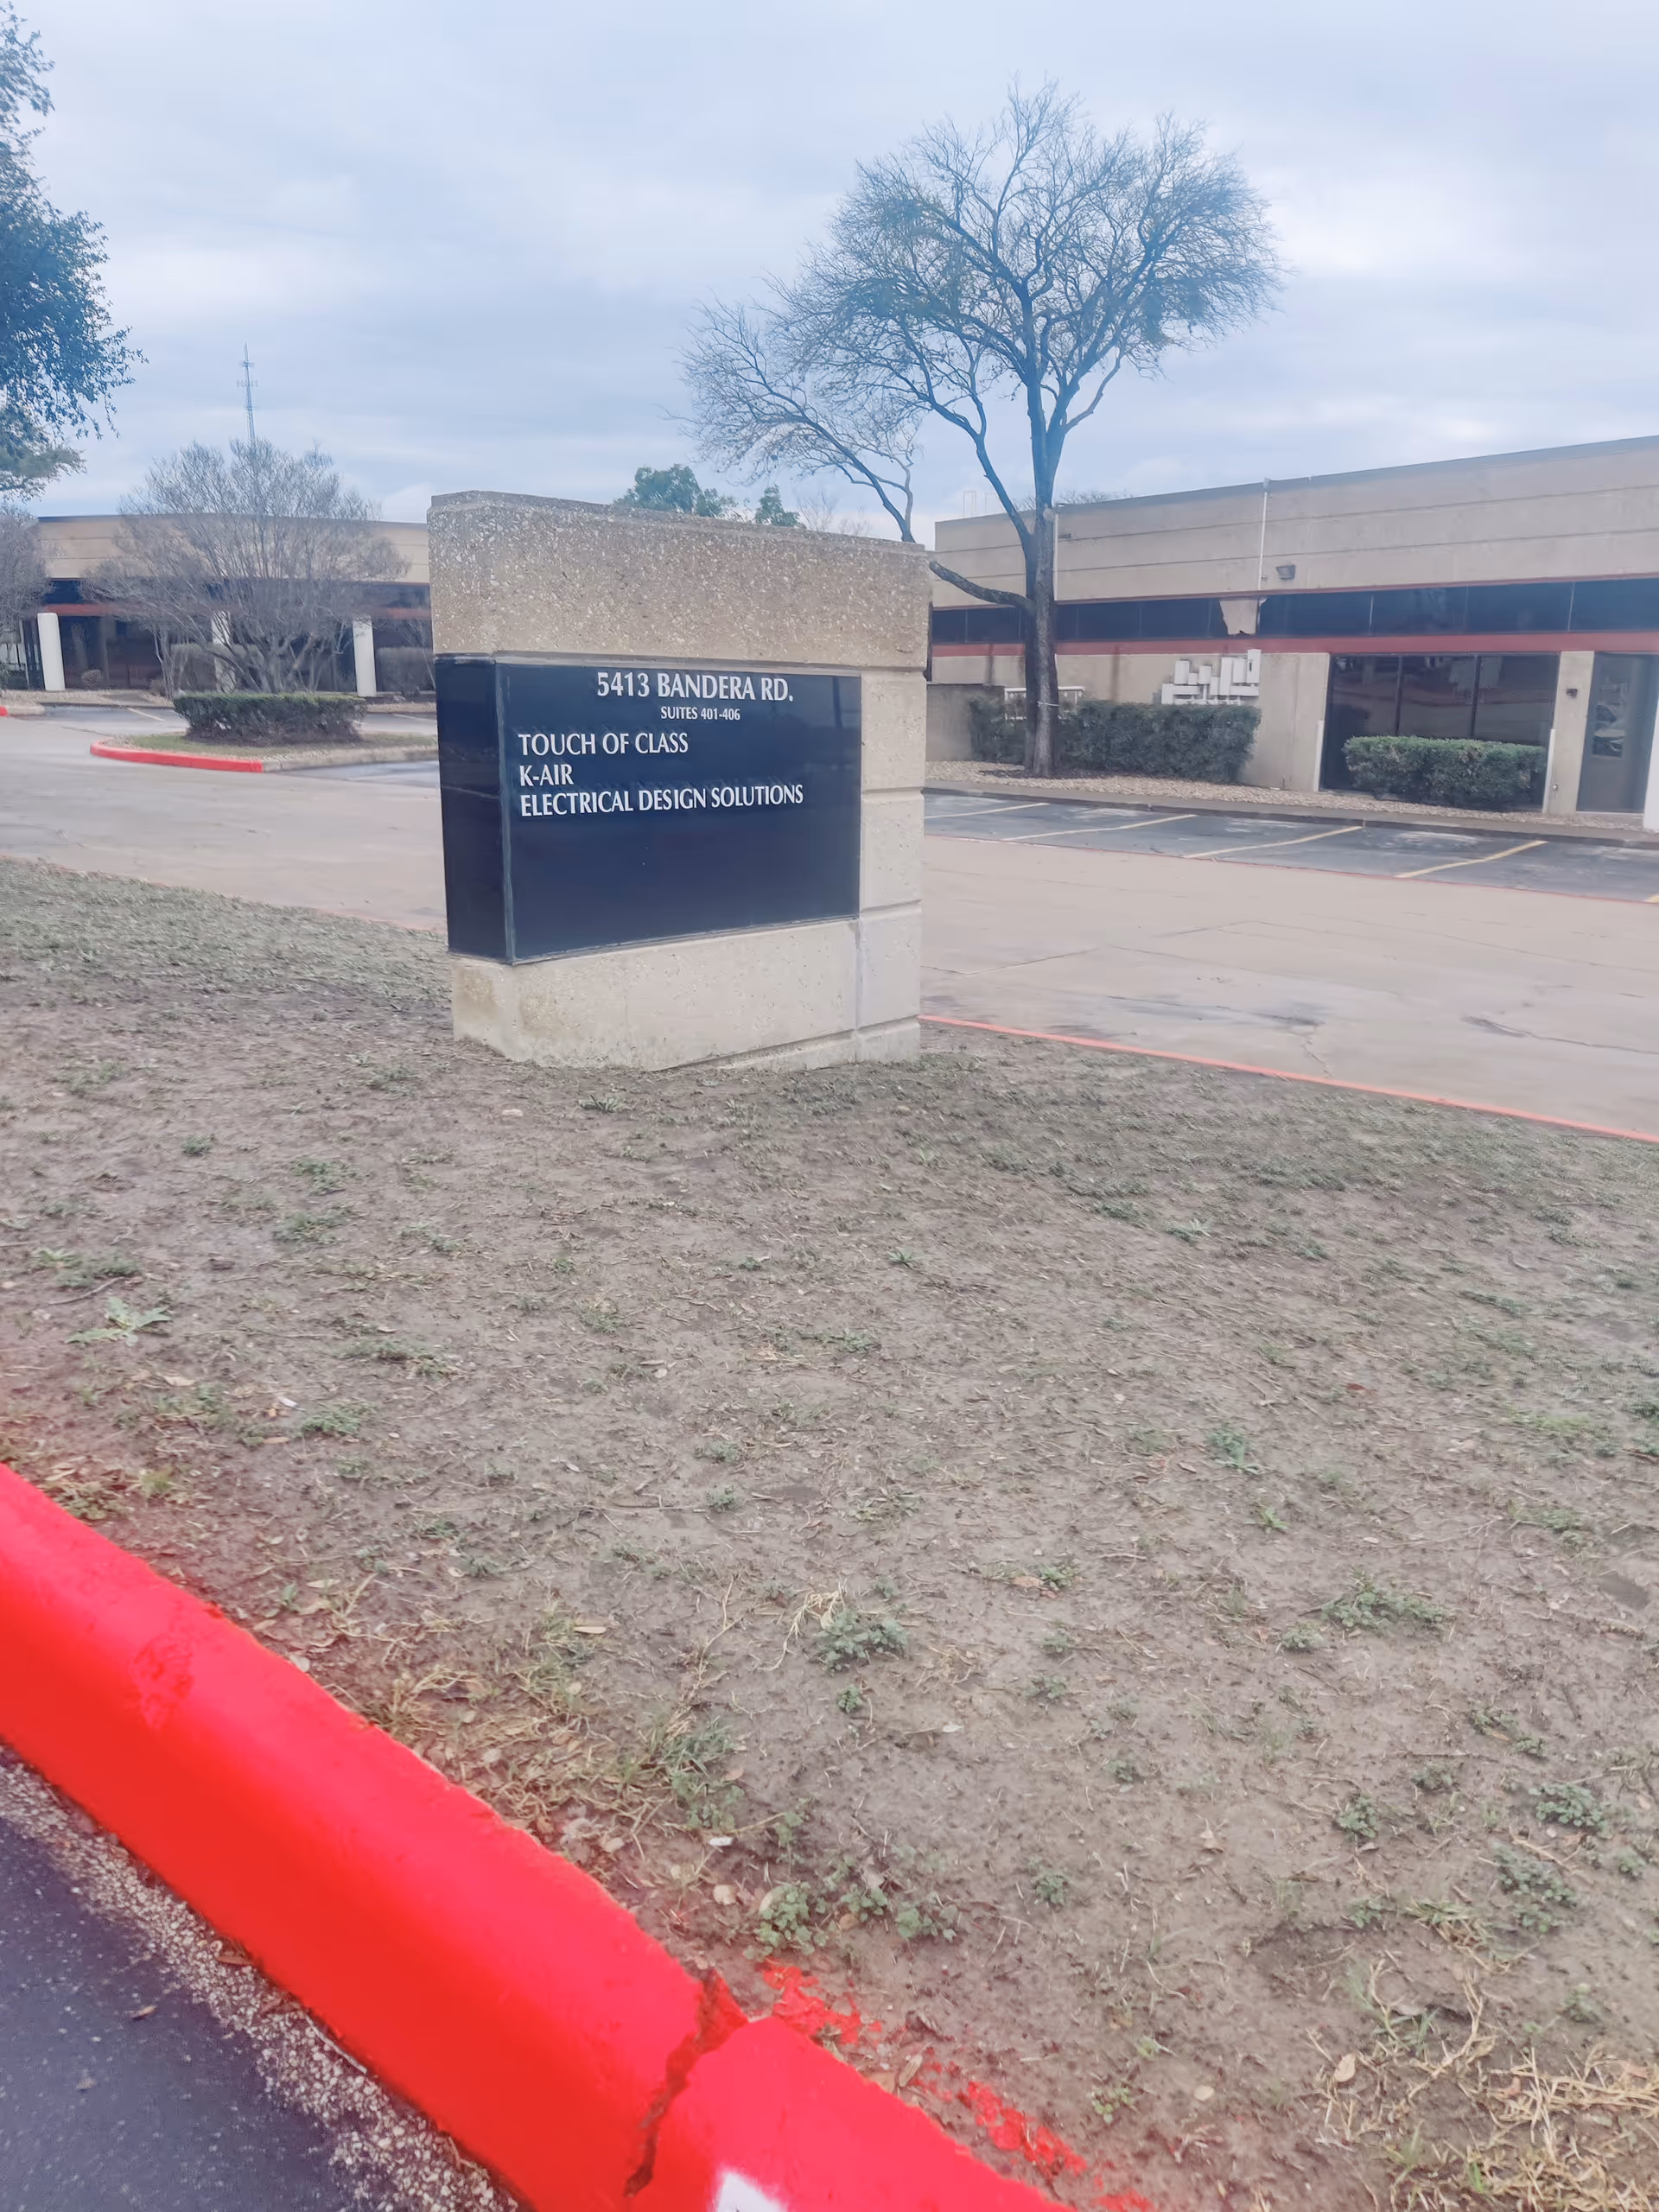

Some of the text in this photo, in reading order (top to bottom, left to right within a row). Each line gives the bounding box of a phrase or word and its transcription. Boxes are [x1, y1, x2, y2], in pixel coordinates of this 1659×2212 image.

[597, 672, 793, 701] 5413 BANDERA RD.
[660, 706, 741, 721] SUITES 401-406
[518, 733, 689, 756] TOUCH OF CLASS
[519, 764, 574, 786] K-AIR
[520, 785, 804, 817] ELECTRICAL DESIGN SOLUTIONS
